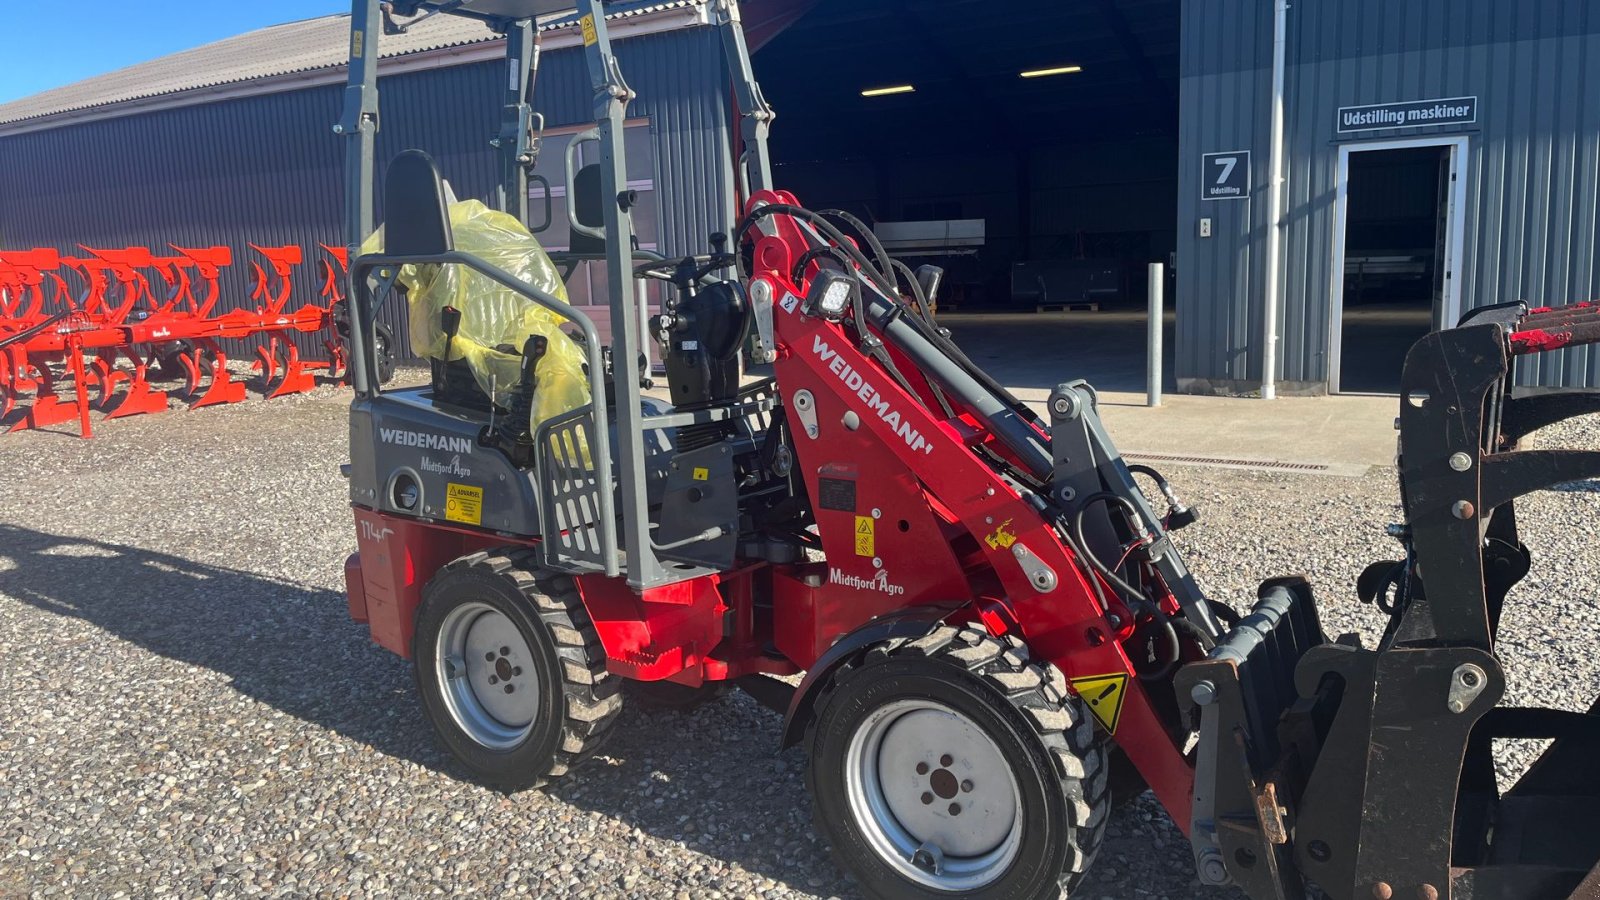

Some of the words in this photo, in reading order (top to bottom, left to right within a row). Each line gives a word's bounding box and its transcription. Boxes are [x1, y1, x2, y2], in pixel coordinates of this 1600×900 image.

[1343, 109, 1405, 126] Udstilling
[1407, 104, 1470, 120] maskiner
[1214, 157, 1237, 184] 7
[1210, 186, 1240, 195] Udstilling
[380, 428, 472, 454] WEIDEMANN
[421, 456, 452, 475] Midtfjord
[453, 458, 471, 478] Agro
[829, 567, 876, 590] Midtfjord
[878, 573, 904, 596] Agro
